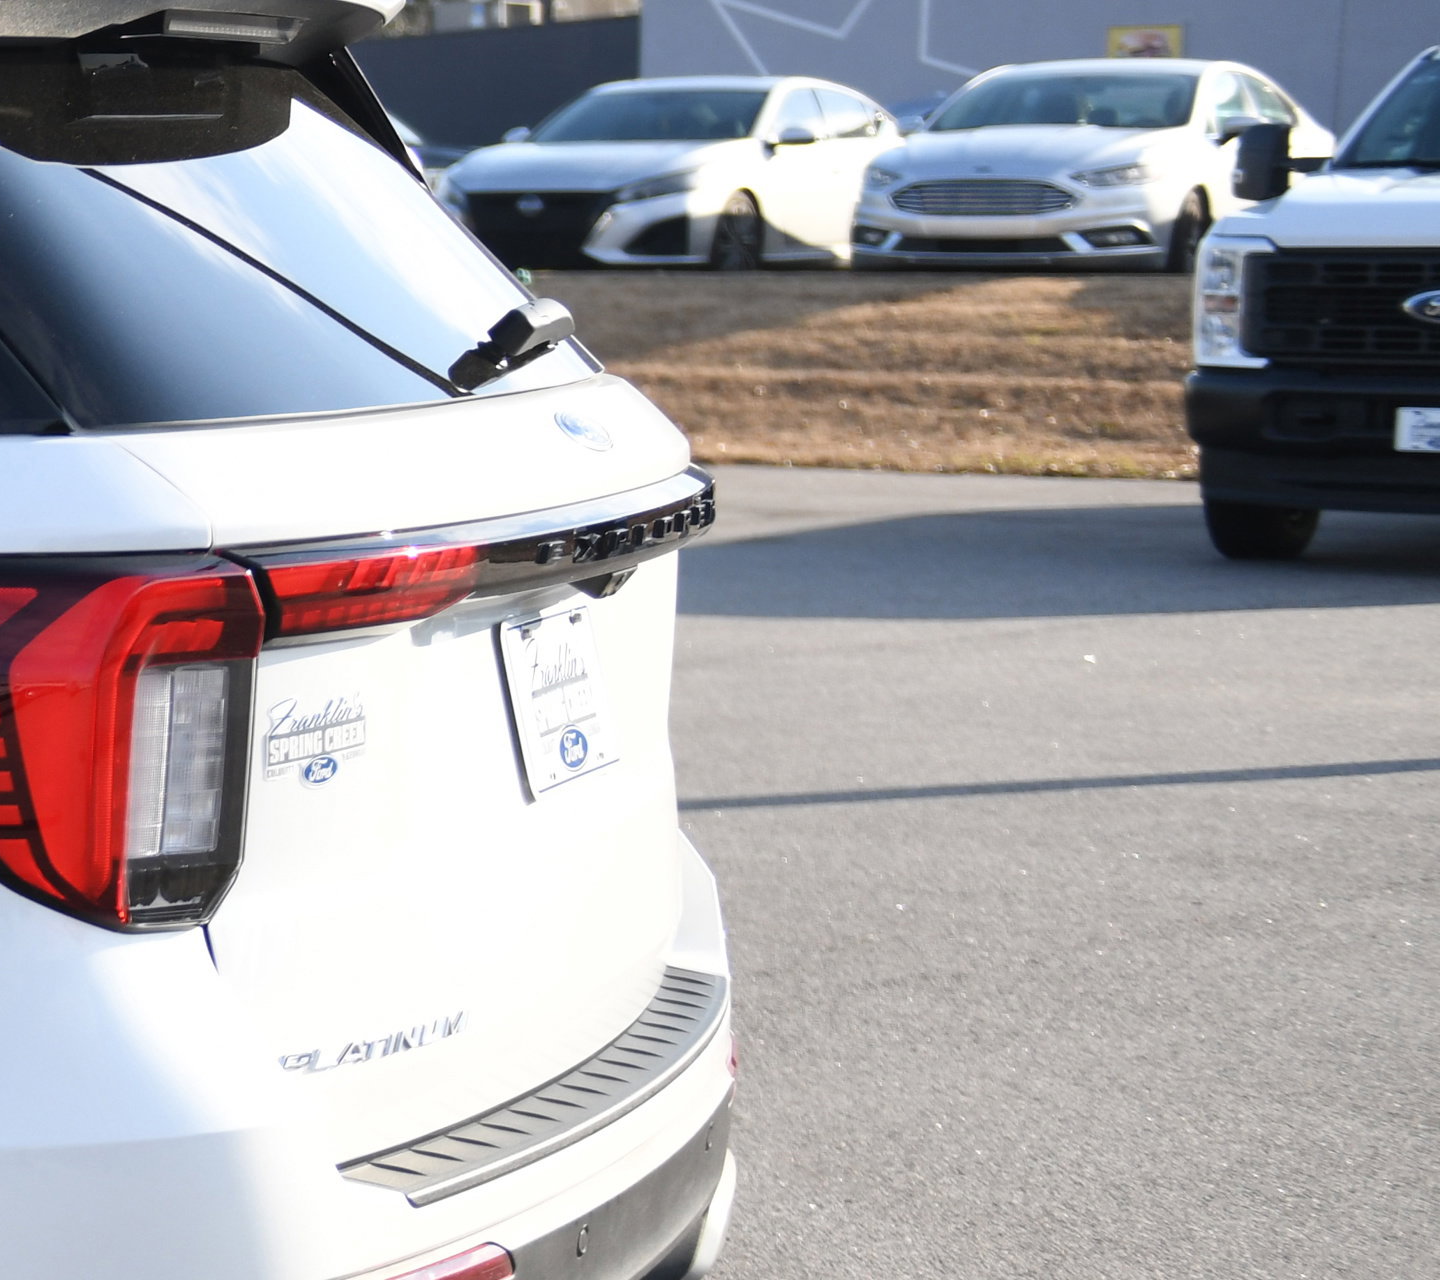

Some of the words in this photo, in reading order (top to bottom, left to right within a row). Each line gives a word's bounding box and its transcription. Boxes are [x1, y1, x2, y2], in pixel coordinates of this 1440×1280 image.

[270, 730, 323, 763] SPRING
[325, 720, 364, 752] CREE
[309, 759, 334, 781] Ford
[279, 1010, 469, 1072] PLATINUM
